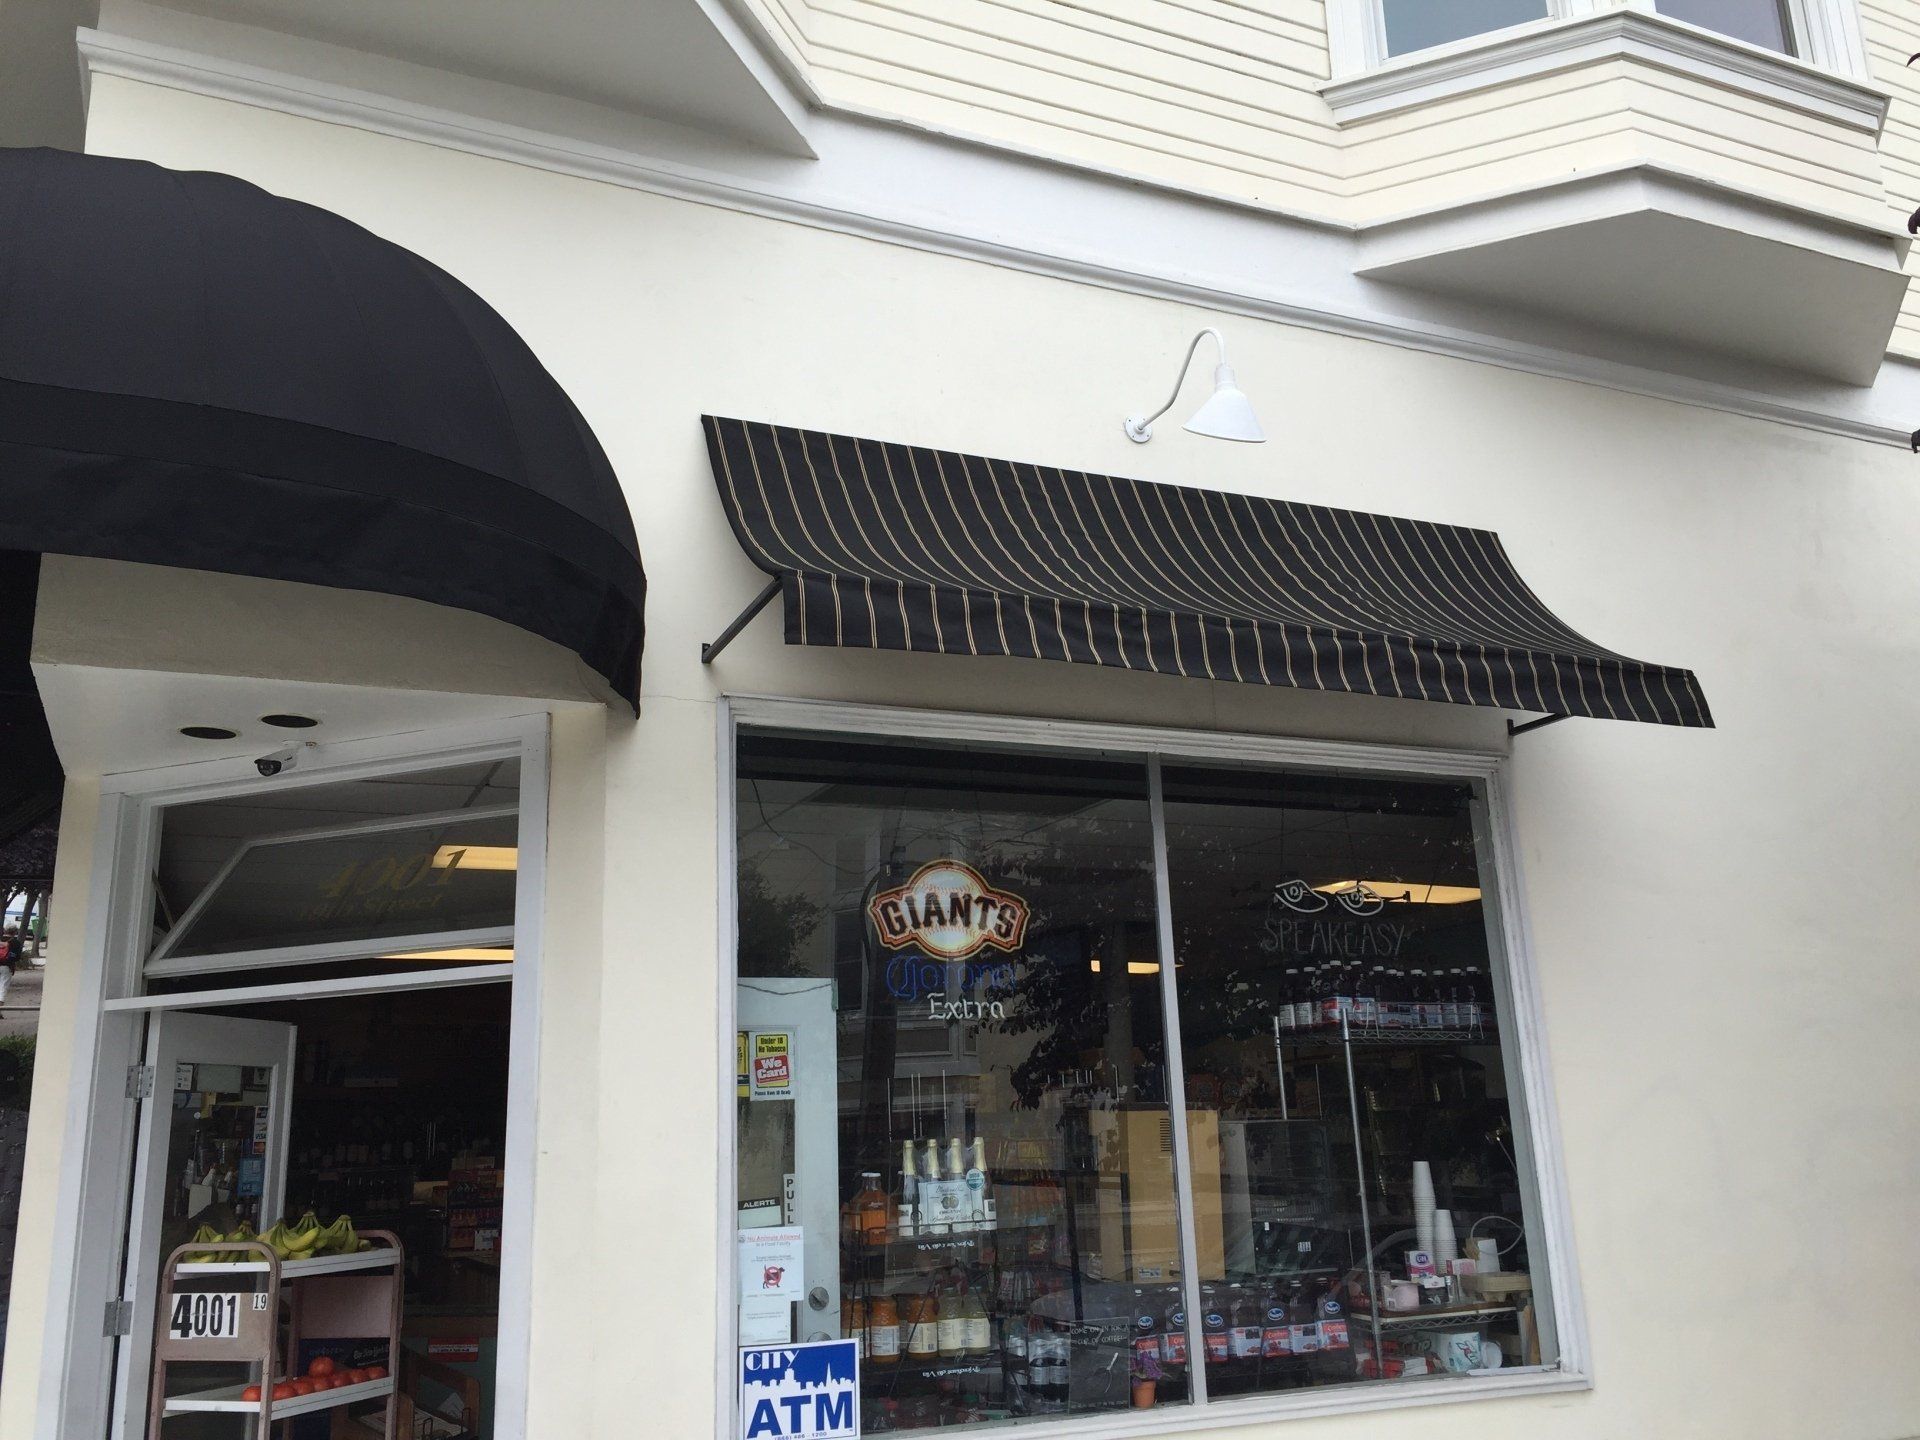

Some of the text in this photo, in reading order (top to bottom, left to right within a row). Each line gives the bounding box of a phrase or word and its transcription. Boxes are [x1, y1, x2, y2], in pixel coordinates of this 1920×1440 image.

[879, 892, 1018, 939] GIANTS
[1262, 918, 1405, 957] SPEAKEASY
[886, 954, 1016, 1003] Corona
[927, 993, 1006, 1020] Extra
[756, 1065, 787, 1079] Card
[760, 1058, 782, 1069] We
[743, 1199, 777, 1208] ALERTE
[786, 1178, 795, 1224] PULL
[171, 1294, 267, 1338] 4001 19
[745, 1350, 800, 1371] CITY
[746, 1390, 853, 1439] ATM
